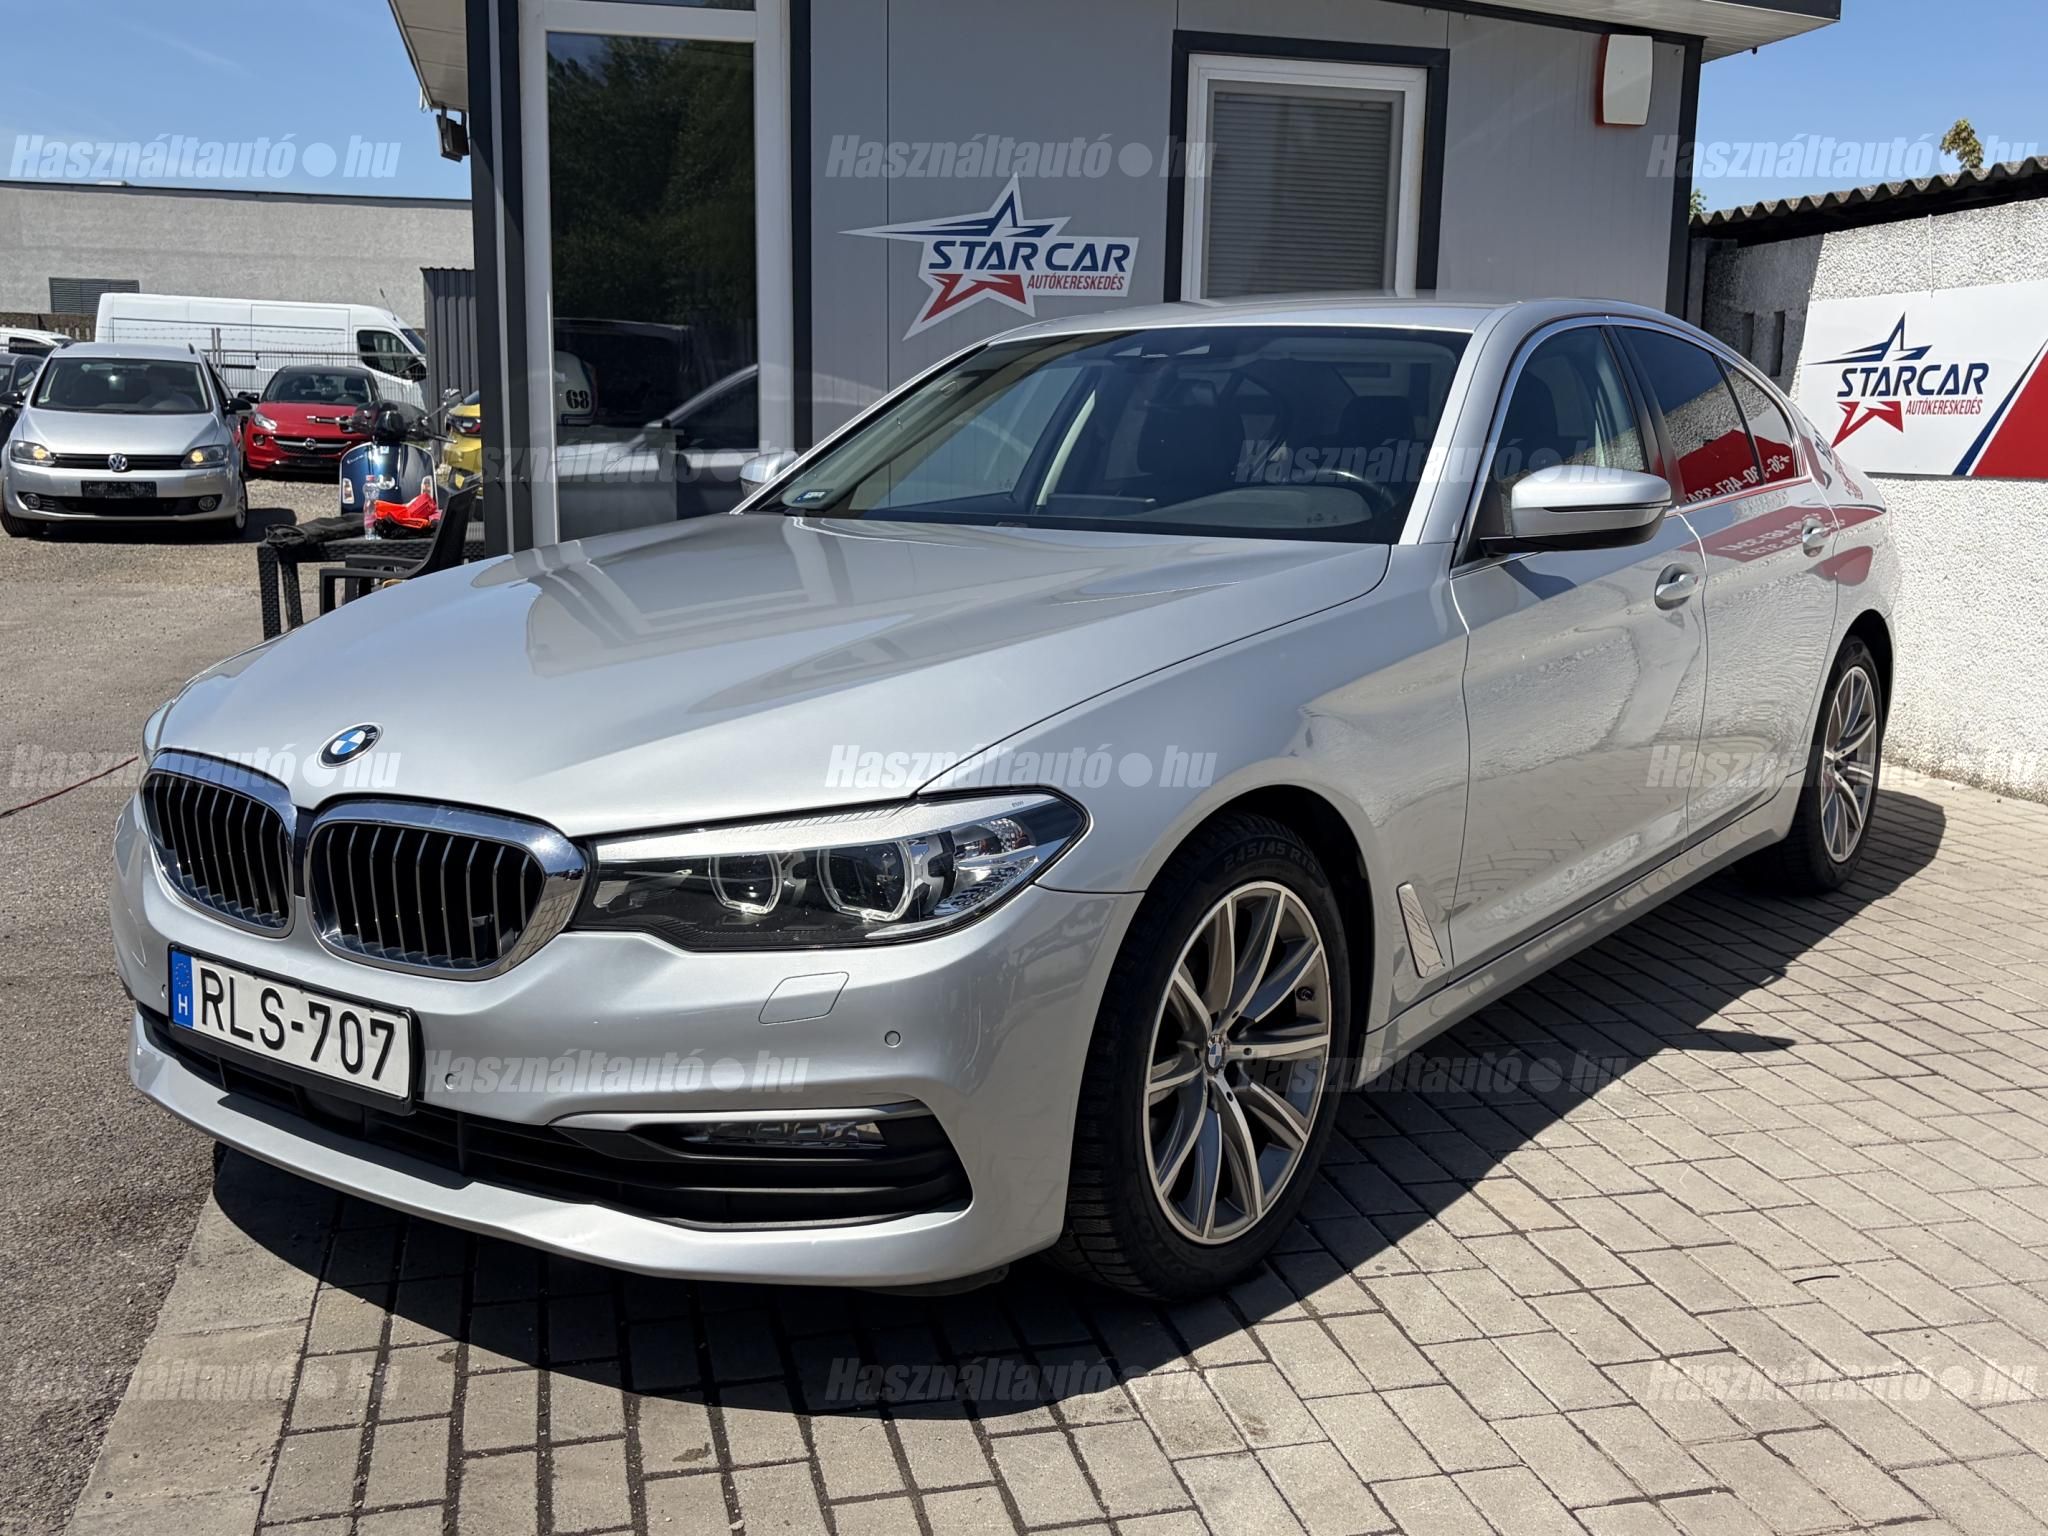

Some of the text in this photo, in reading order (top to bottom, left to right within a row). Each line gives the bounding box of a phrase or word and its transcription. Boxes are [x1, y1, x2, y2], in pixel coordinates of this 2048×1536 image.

[1027, 272, 1125, 290] AUTÓKERESKEDÉS
[565, 389, 590, 409] 68
[1905, 397, 1983, 415] AUTÓKERESKEDÉS
[178, 993, 189, 1016] H
[200, 967, 395, 1081] RLS-707
